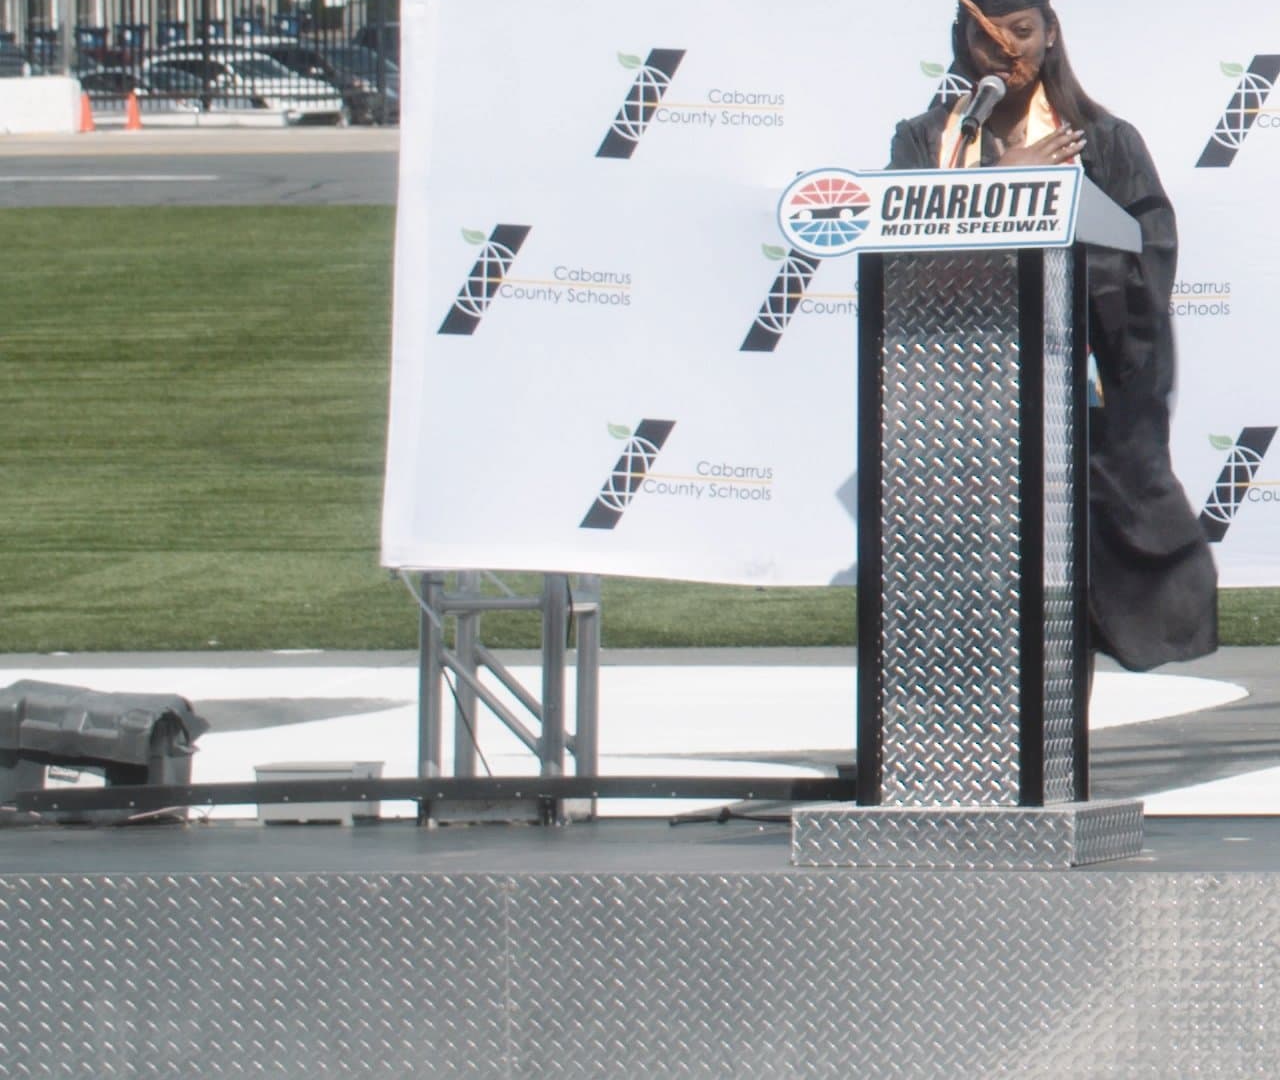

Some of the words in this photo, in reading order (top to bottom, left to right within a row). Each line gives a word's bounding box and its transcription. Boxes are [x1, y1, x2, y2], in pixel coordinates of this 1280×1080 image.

[709, 89, 784, 104] Cabarrus
[655, 106, 714, 126] County
[722, 111, 783, 126] Schools
[881, 181, 1061, 221] CHARLOTTE
[881, 223, 950, 237] MOTOR
[554, 266, 630, 284] Cabarrus
[500, 284, 561, 304] County
[568, 288, 630, 305] Schools
[1172, 280, 1231, 294] abarrus
[697, 461, 772, 479] Cabarrus
[642, 479, 704, 498] County
[709, 484, 770, 500] Schools
